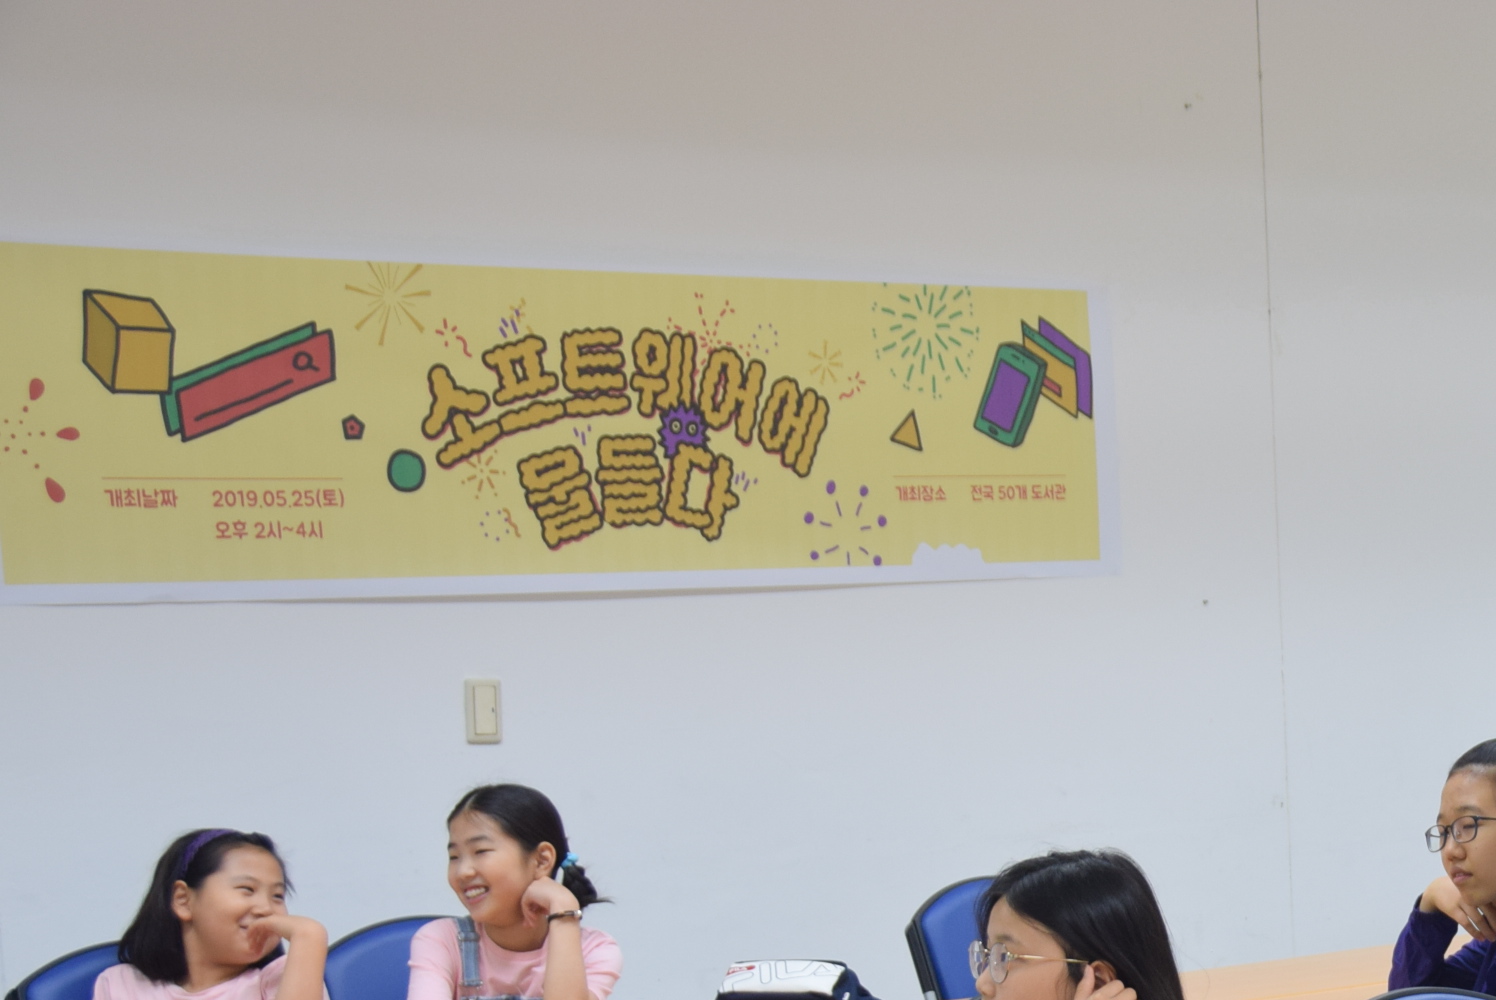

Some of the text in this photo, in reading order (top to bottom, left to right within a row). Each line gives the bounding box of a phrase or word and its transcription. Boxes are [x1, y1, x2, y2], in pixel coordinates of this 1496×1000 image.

[421, 327, 829, 478] 소프트웨어에
[104, 488, 179, 509] 개최날짜
[212, 488, 345, 509] 2019.05.25(토)
[517, 434, 740, 550] 물들다
[895, 485, 946, 502] 개최장소
[971, 484, 1067, 502] 전국 50개 도서관
[214, 519, 324, 540] 오후 2시~4시
